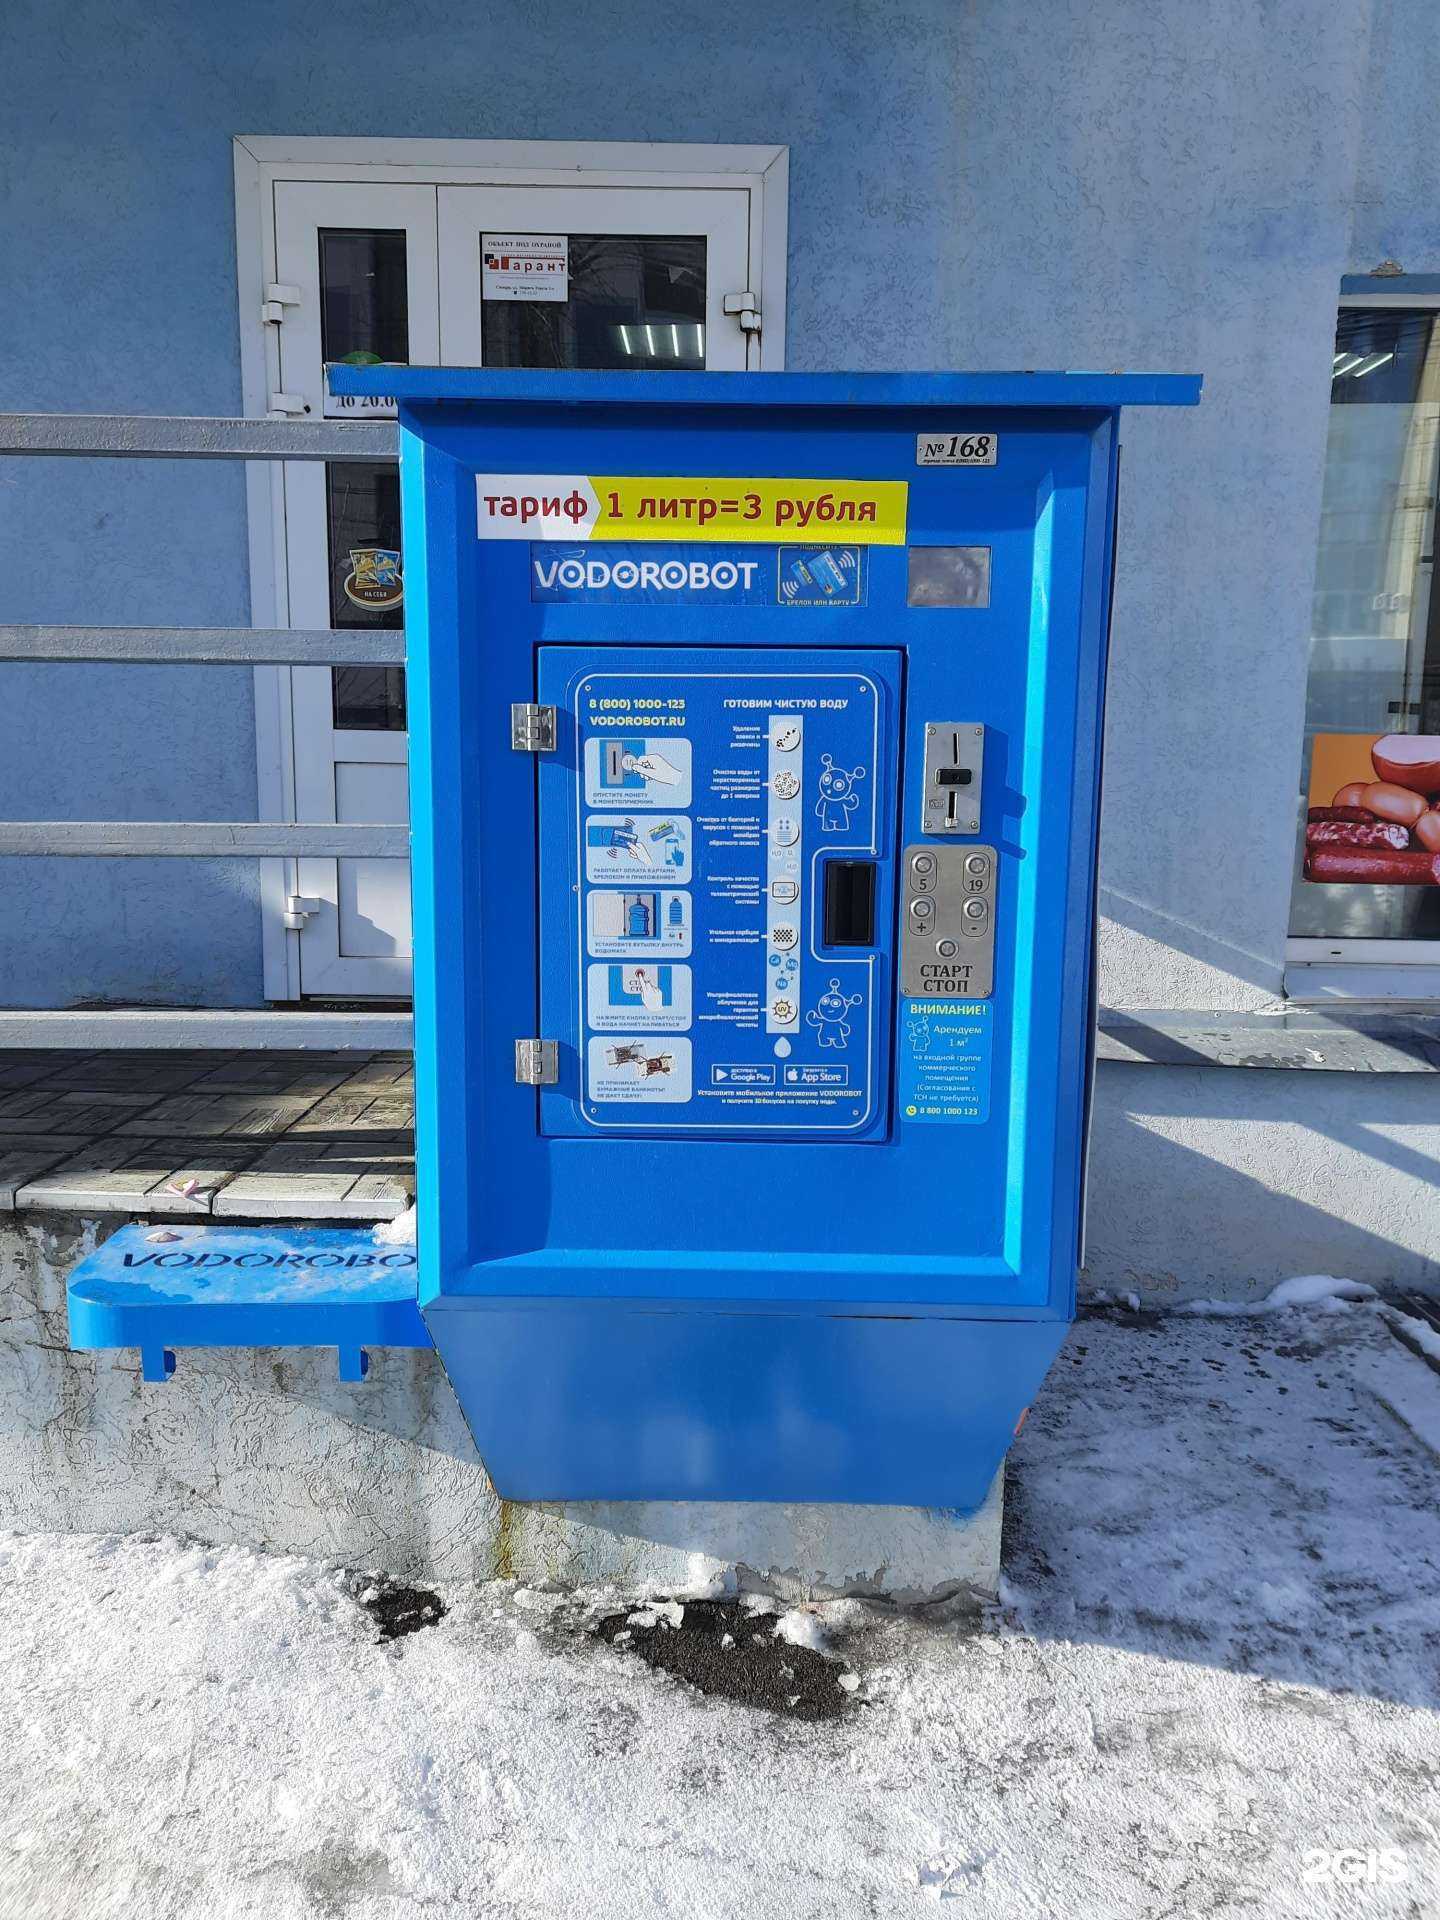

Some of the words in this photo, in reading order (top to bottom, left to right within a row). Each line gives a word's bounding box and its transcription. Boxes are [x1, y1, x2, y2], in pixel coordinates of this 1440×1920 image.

[946, 436, 991, 458] 168
[483, 490, 588, 524] тариф
[607, 492, 624, 518] 1
[636, 494, 763, 526] литр=3
[775, 494, 877, 528] рубля
[534, 560, 759, 590] VODOROBOT
[589, 699, 597, 708] 8
[600, 699, 631, 711] (800)
[633, 699, 686, 709] 1000-123
[723, 699, 773, 709] ГОТОВИМ
[774, 699, 817, 709] ЧИСТУЮ
[820, 699, 849, 710] ВОДУ
[589, 716, 686, 726] VODOROBOT.RU
[919, 878, 927, 890] 5
[968, 879, 984, 891] 19
[920, 964, 974, 978] СТАРТ
[923, 979, 969, 993] СТОП
[777, 1005, 788, 1013] UV
[910, 1004, 987, 1016] ВНИМАНИЕ!
[933, 1025, 982, 1035] Арендуем
[924, 1054, 956, 1062] входной
[956, 1055, 982, 1063] группе
[918, 1065, 976, 1073] коммерческого
[730, 1073, 755, 1082] Google
[756, 1073, 771, 1083] Play
[801, 1072, 819, 1083] App
[820, 1072, 842, 1081] Store
[925, 1075, 969, 1083] помещения
[697, 1089, 735, 1097] Установите
[735, 1089, 774, 1097] мобильное
[775, 1090, 819, 1098] приложение
[926, 1107, 941, 1115] 800
[122, 1252, 417, 1268] VODOROBO
